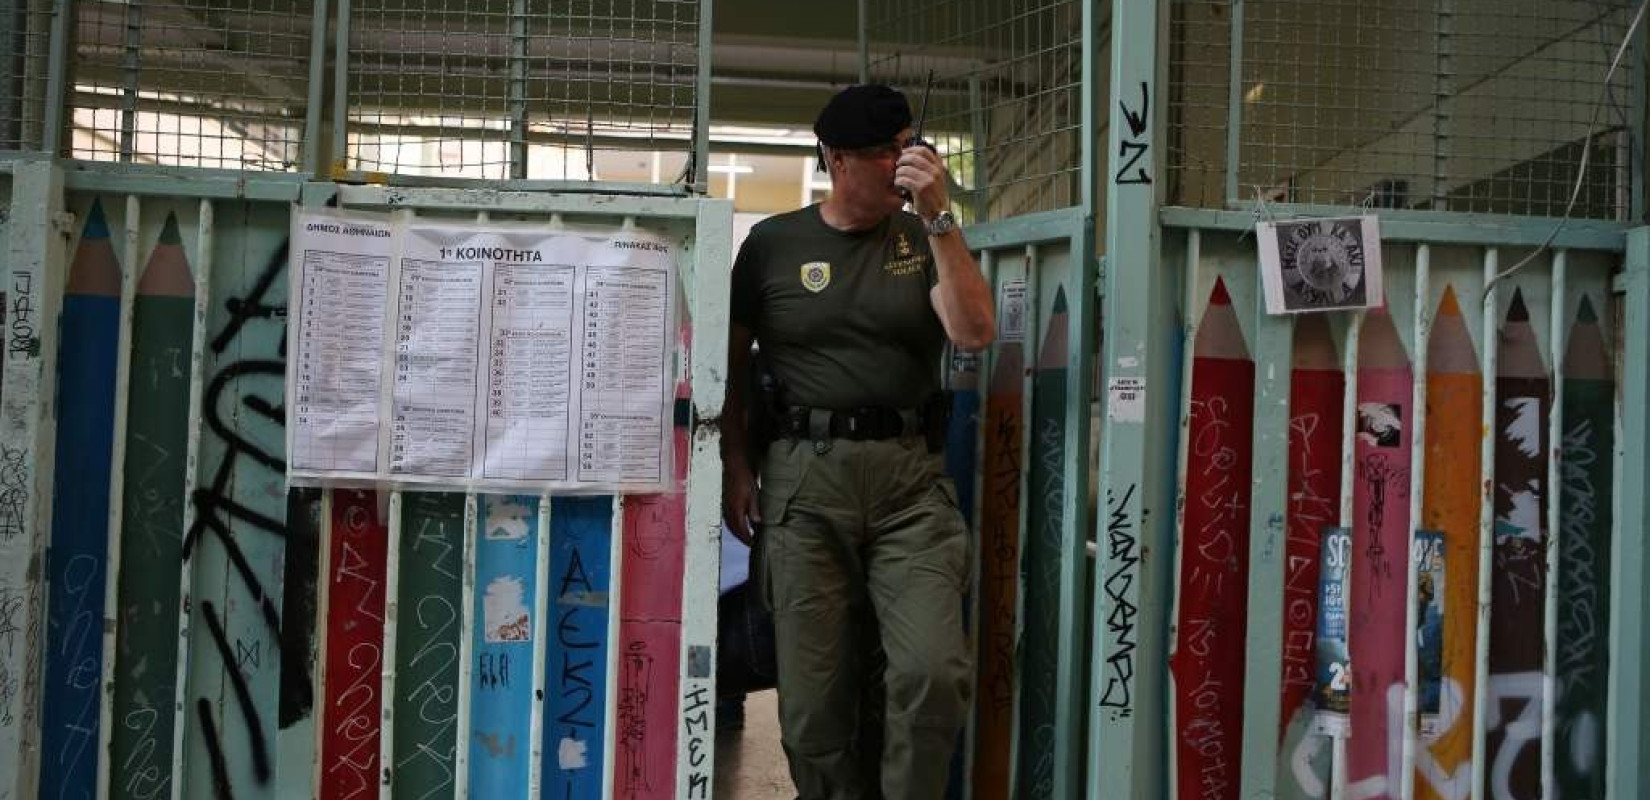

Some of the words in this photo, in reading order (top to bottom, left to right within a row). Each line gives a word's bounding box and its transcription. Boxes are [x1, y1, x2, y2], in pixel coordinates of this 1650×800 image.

[306, 223, 340, 235] ΔΗΜΟΣ
[342, 227, 391, 239] ΑΘΗΝΑΙΩΝ
[455, 248, 543, 262] ΚΟΙΝΟΤΗΤΑ
